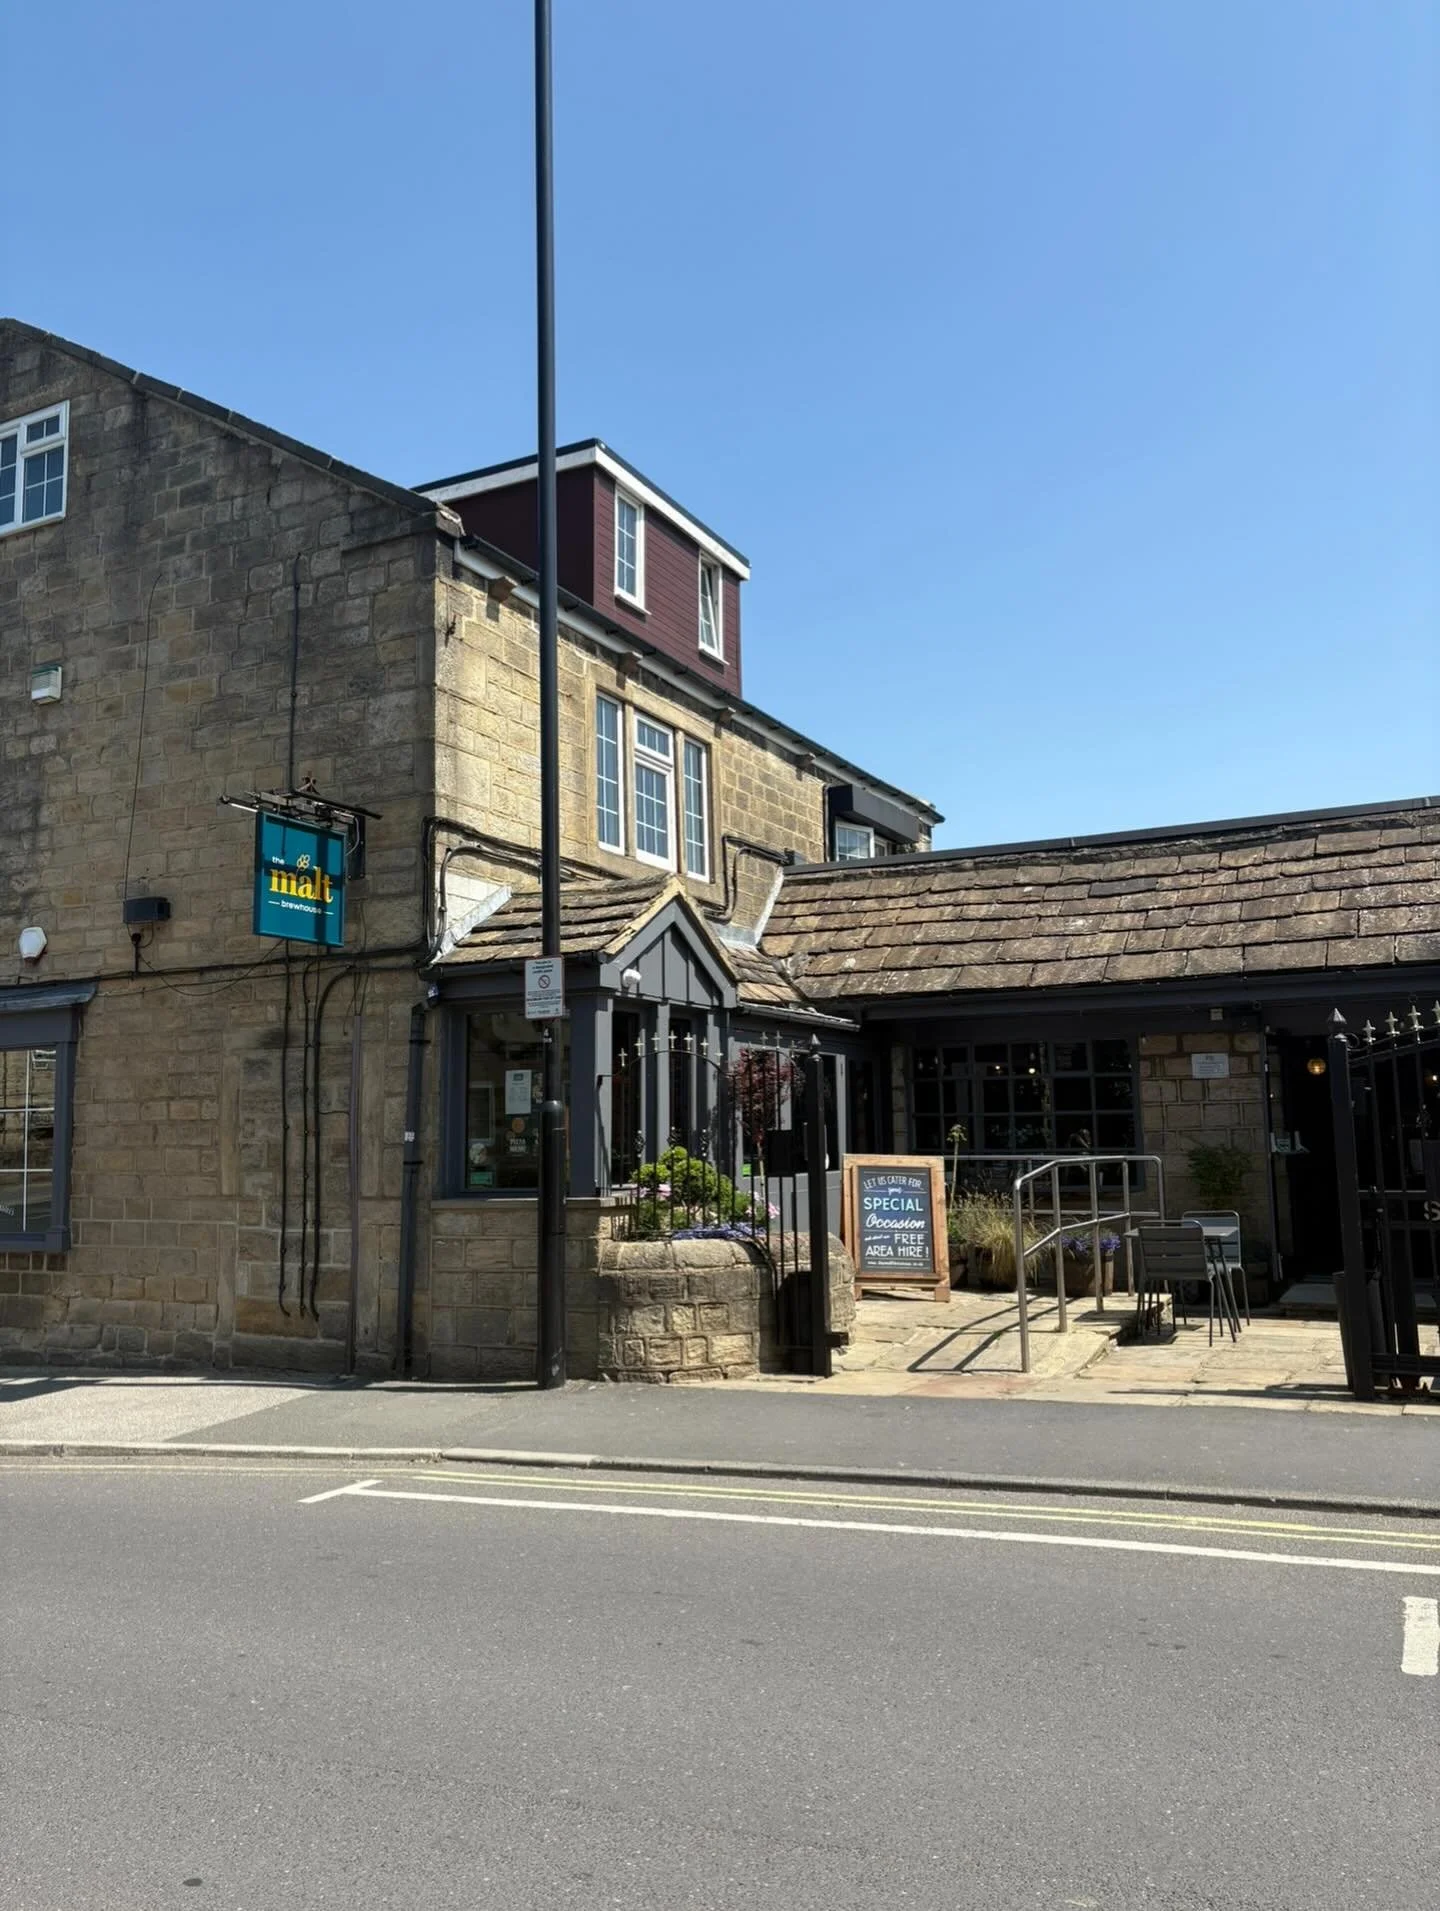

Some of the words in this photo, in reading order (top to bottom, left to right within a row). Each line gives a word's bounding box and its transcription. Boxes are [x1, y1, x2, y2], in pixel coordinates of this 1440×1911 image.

[272, 856, 285, 865] the
[269, 866, 334, 903] malt
[280, 900, 322, 915] brewhouse
[863, 1177, 876, 1190] LET
[877, 1175, 887, 1186] US
[887, 1175, 907, 1186] CATER
[908, 1177, 923, 1189] FOR
[863, 1197, 924, 1211] SPECIAL
[865, 1213, 926, 1229] Occasion
[894, 1233, 925, 1245] FREE
[865, 1245, 894, 1257] AREA
